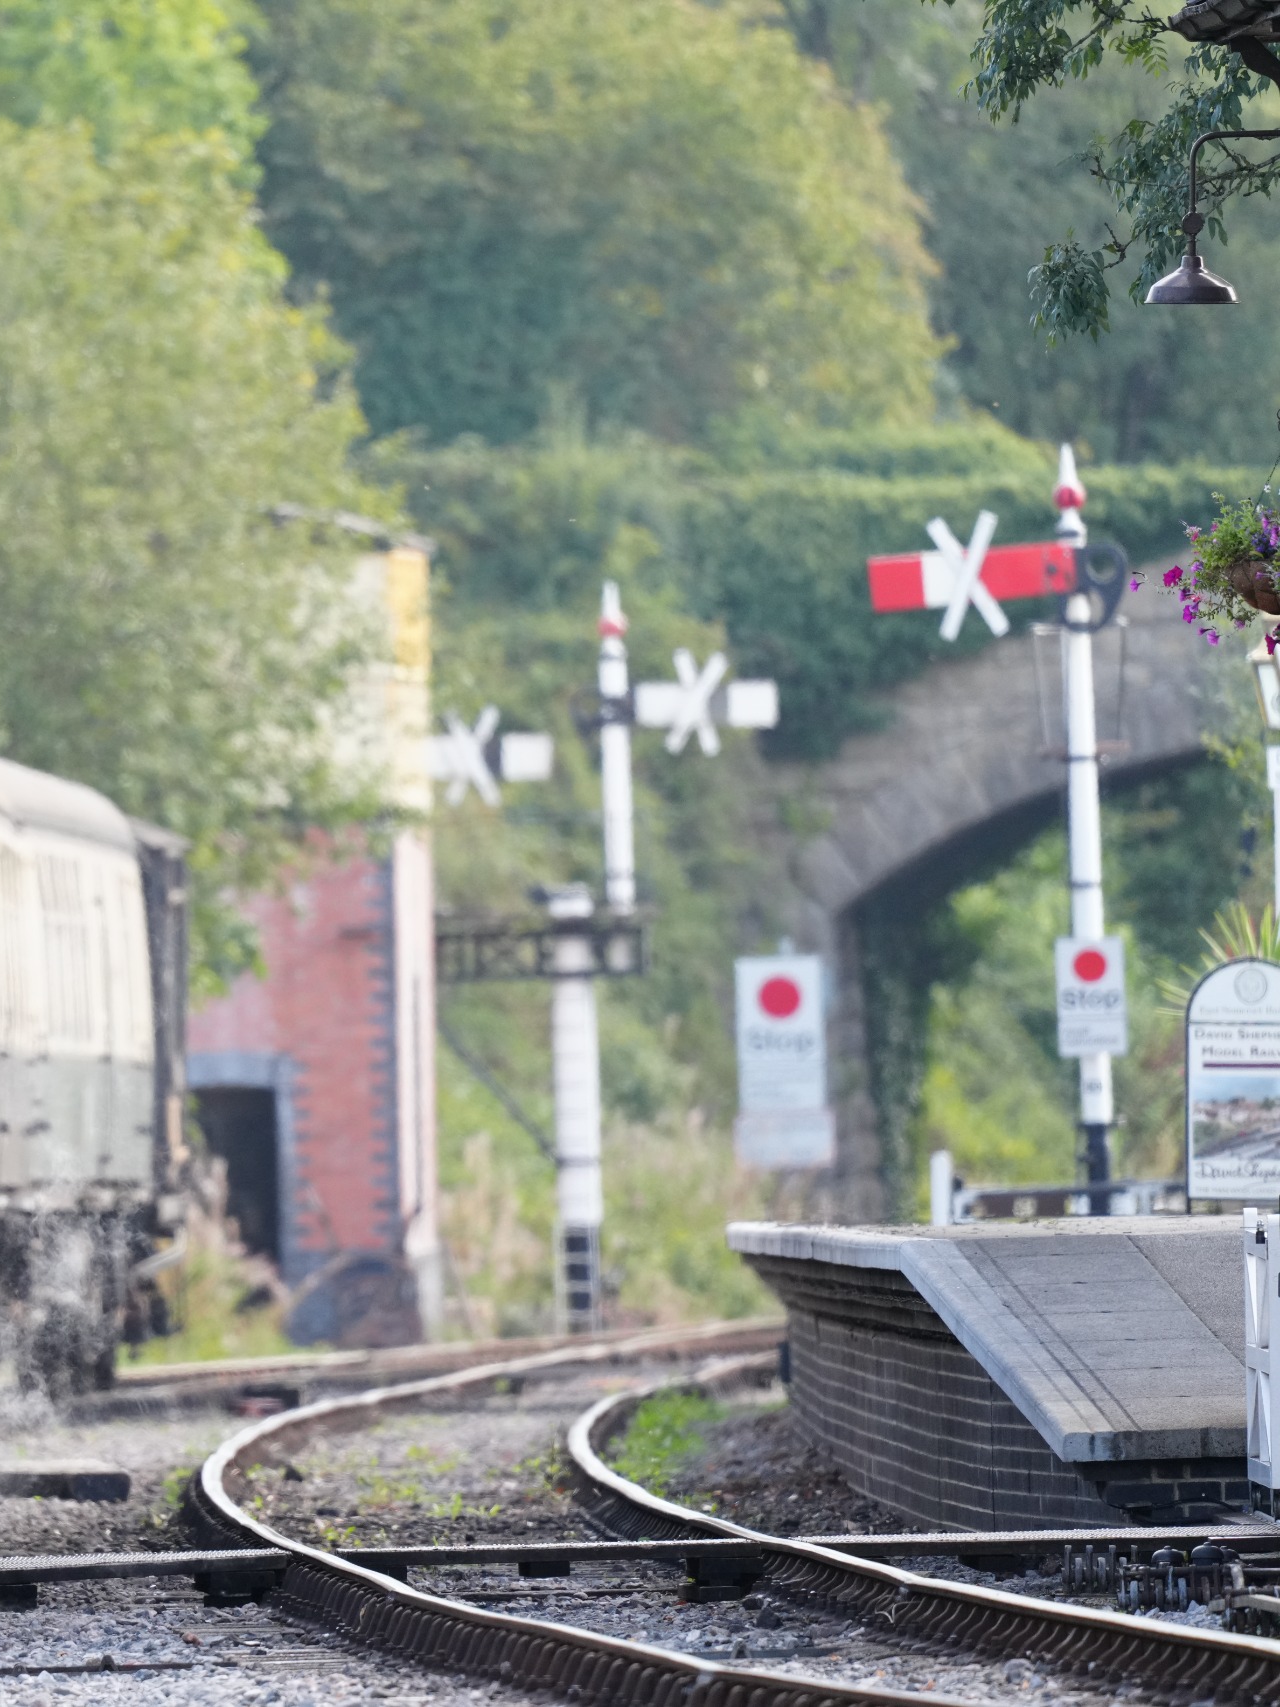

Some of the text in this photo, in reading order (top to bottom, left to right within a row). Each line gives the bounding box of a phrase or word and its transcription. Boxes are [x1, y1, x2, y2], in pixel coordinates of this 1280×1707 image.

[1061, 987, 1121, 1014] Stop
[748, 1028, 815, 1058] Stop
[1194, 1027, 1233, 1040] DAVID
[1202, 1045, 1243, 1057] MODEL
